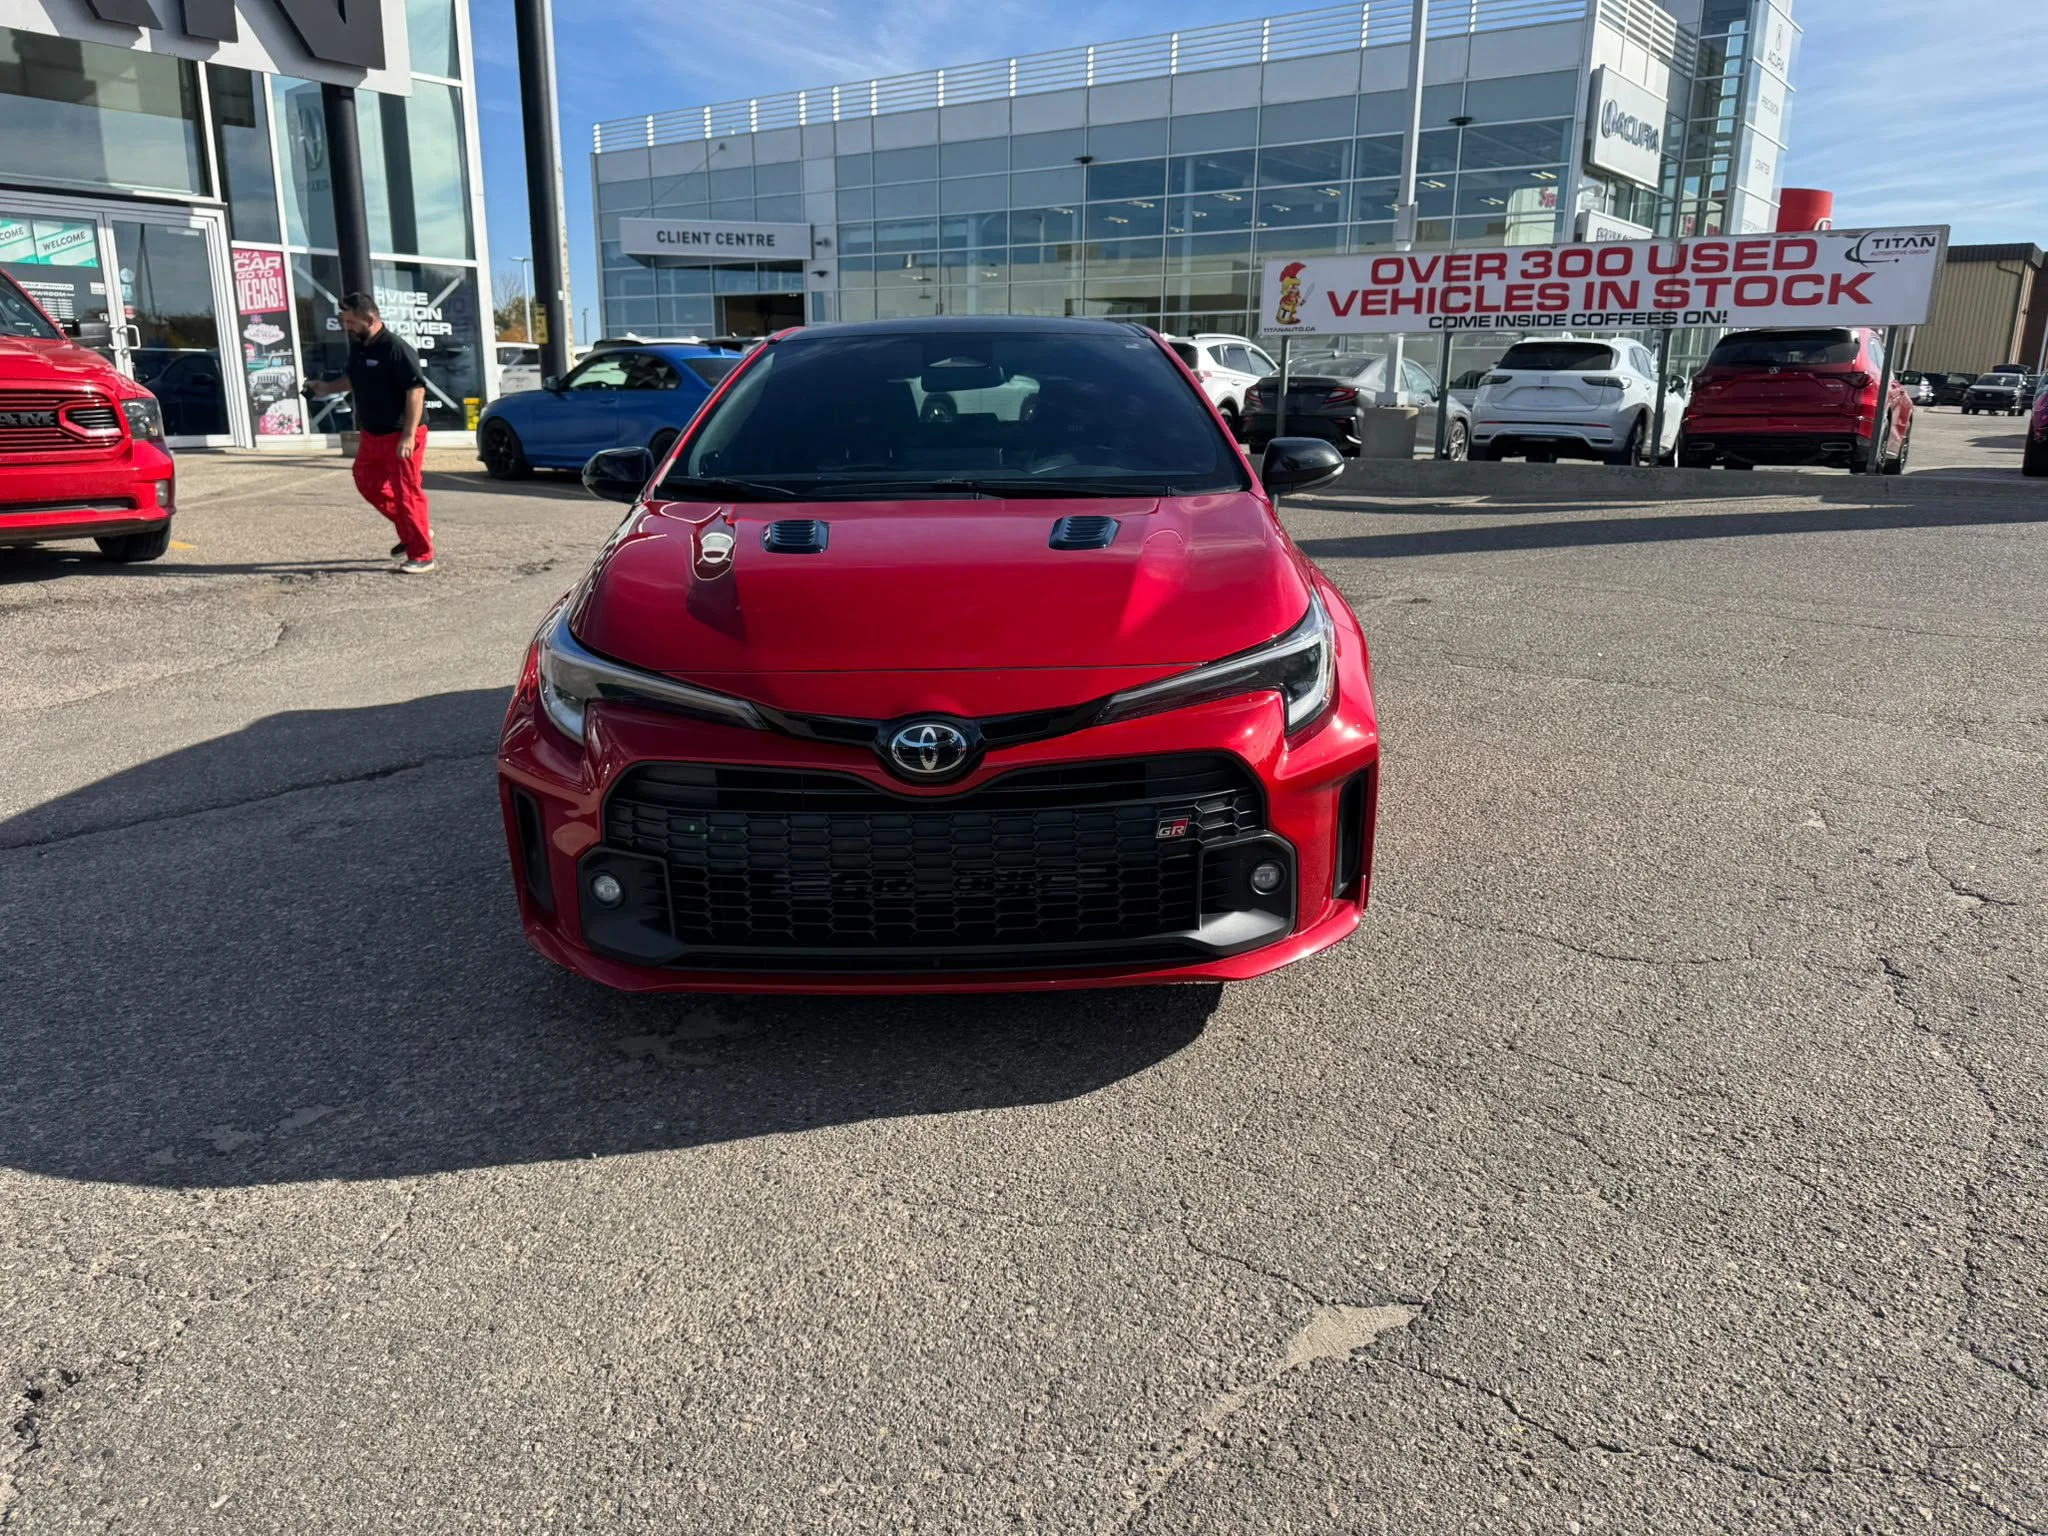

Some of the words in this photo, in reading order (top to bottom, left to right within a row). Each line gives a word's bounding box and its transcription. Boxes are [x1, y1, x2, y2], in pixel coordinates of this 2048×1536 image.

[1614, 112, 1660, 155] ACURA
[42, 231, 86, 251] WELCOME
[656, 230, 711, 245] CLIENT
[715, 232, 775, 247] CENTRE
[1871, 236, 1936, 250] TITAN
[234, 256, 282, 272] CAR
[1371, 252, 1508, 286] OVER
[1520, 246, 1633, 280] 300
[1647, 238, 1818, 275] USED
[236, 271, 255, 280] GO
[256, 269, 274, 278] TO
[236, 276, 285, 311] VEGAS!
[374, 286, 429, 306] RVICE
[1327, 282, 1570, 317] VEHICLES
[1584, 279, 1640, 311] IN
[1652, 271, 1877, 310] STOCK
[1429, 315, 1490, 329] COME
[1495, 313, 1567, 328] INSIDE
[1571, 311, 1677, 327] COFFEES
[1683, 310, 1728, 325] ON!
[1159, 825, 1185, 837] GR
